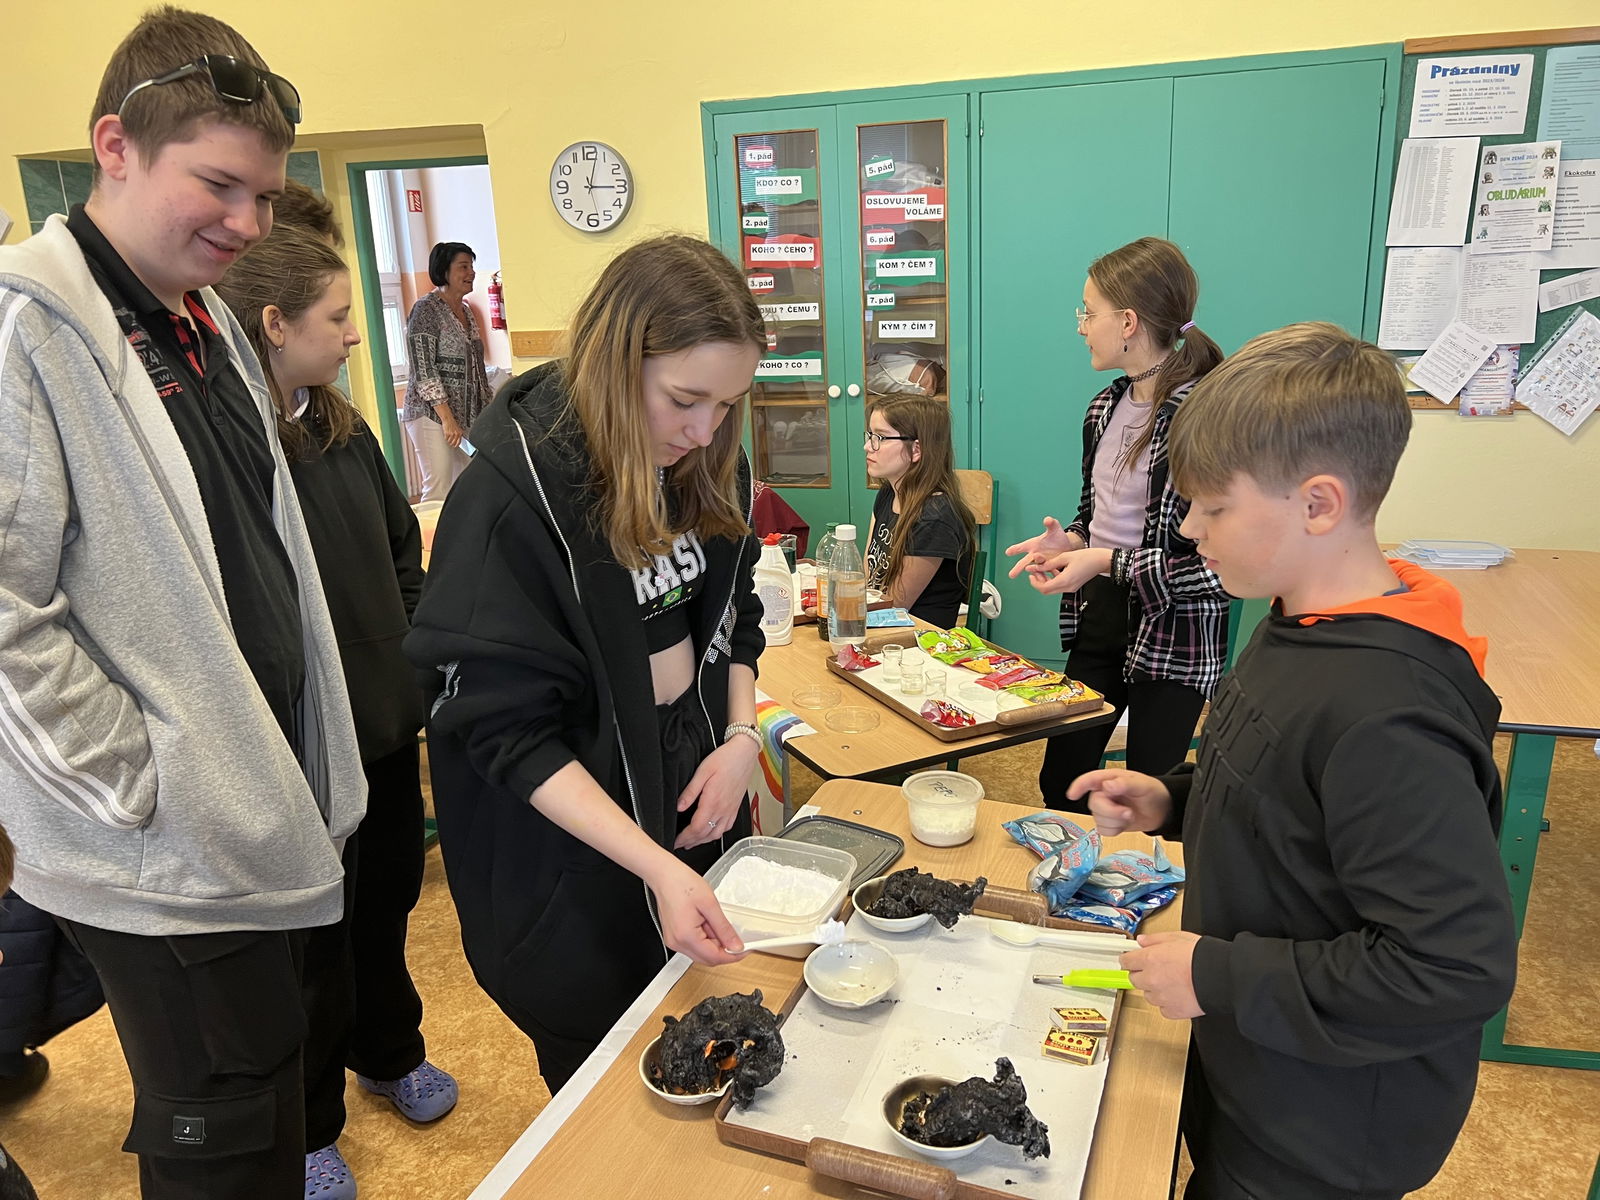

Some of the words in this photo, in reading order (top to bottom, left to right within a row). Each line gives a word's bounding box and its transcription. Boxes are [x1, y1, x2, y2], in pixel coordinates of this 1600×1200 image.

[573, 152, 578, 163] 11
[582, 146, 597, 160] 12
[559, 165, 572, 176] 10
[611, 164, 621, 175] 2
[878, 163, 892, 172] pád
[556, 180, 569, 194] 9
[615, 179, 627, 194] 3
[1487, 187, 1546, 202] OBLUDÁRIUM
[563, 198, 573, 209] 8
[612, 198, 622, 209] 4
[574, 210, 583, 221] 7
[587, 213, 600, 227] 6
[604, 210, 612, 221] 5
[879, 235, 893, 244] pád
